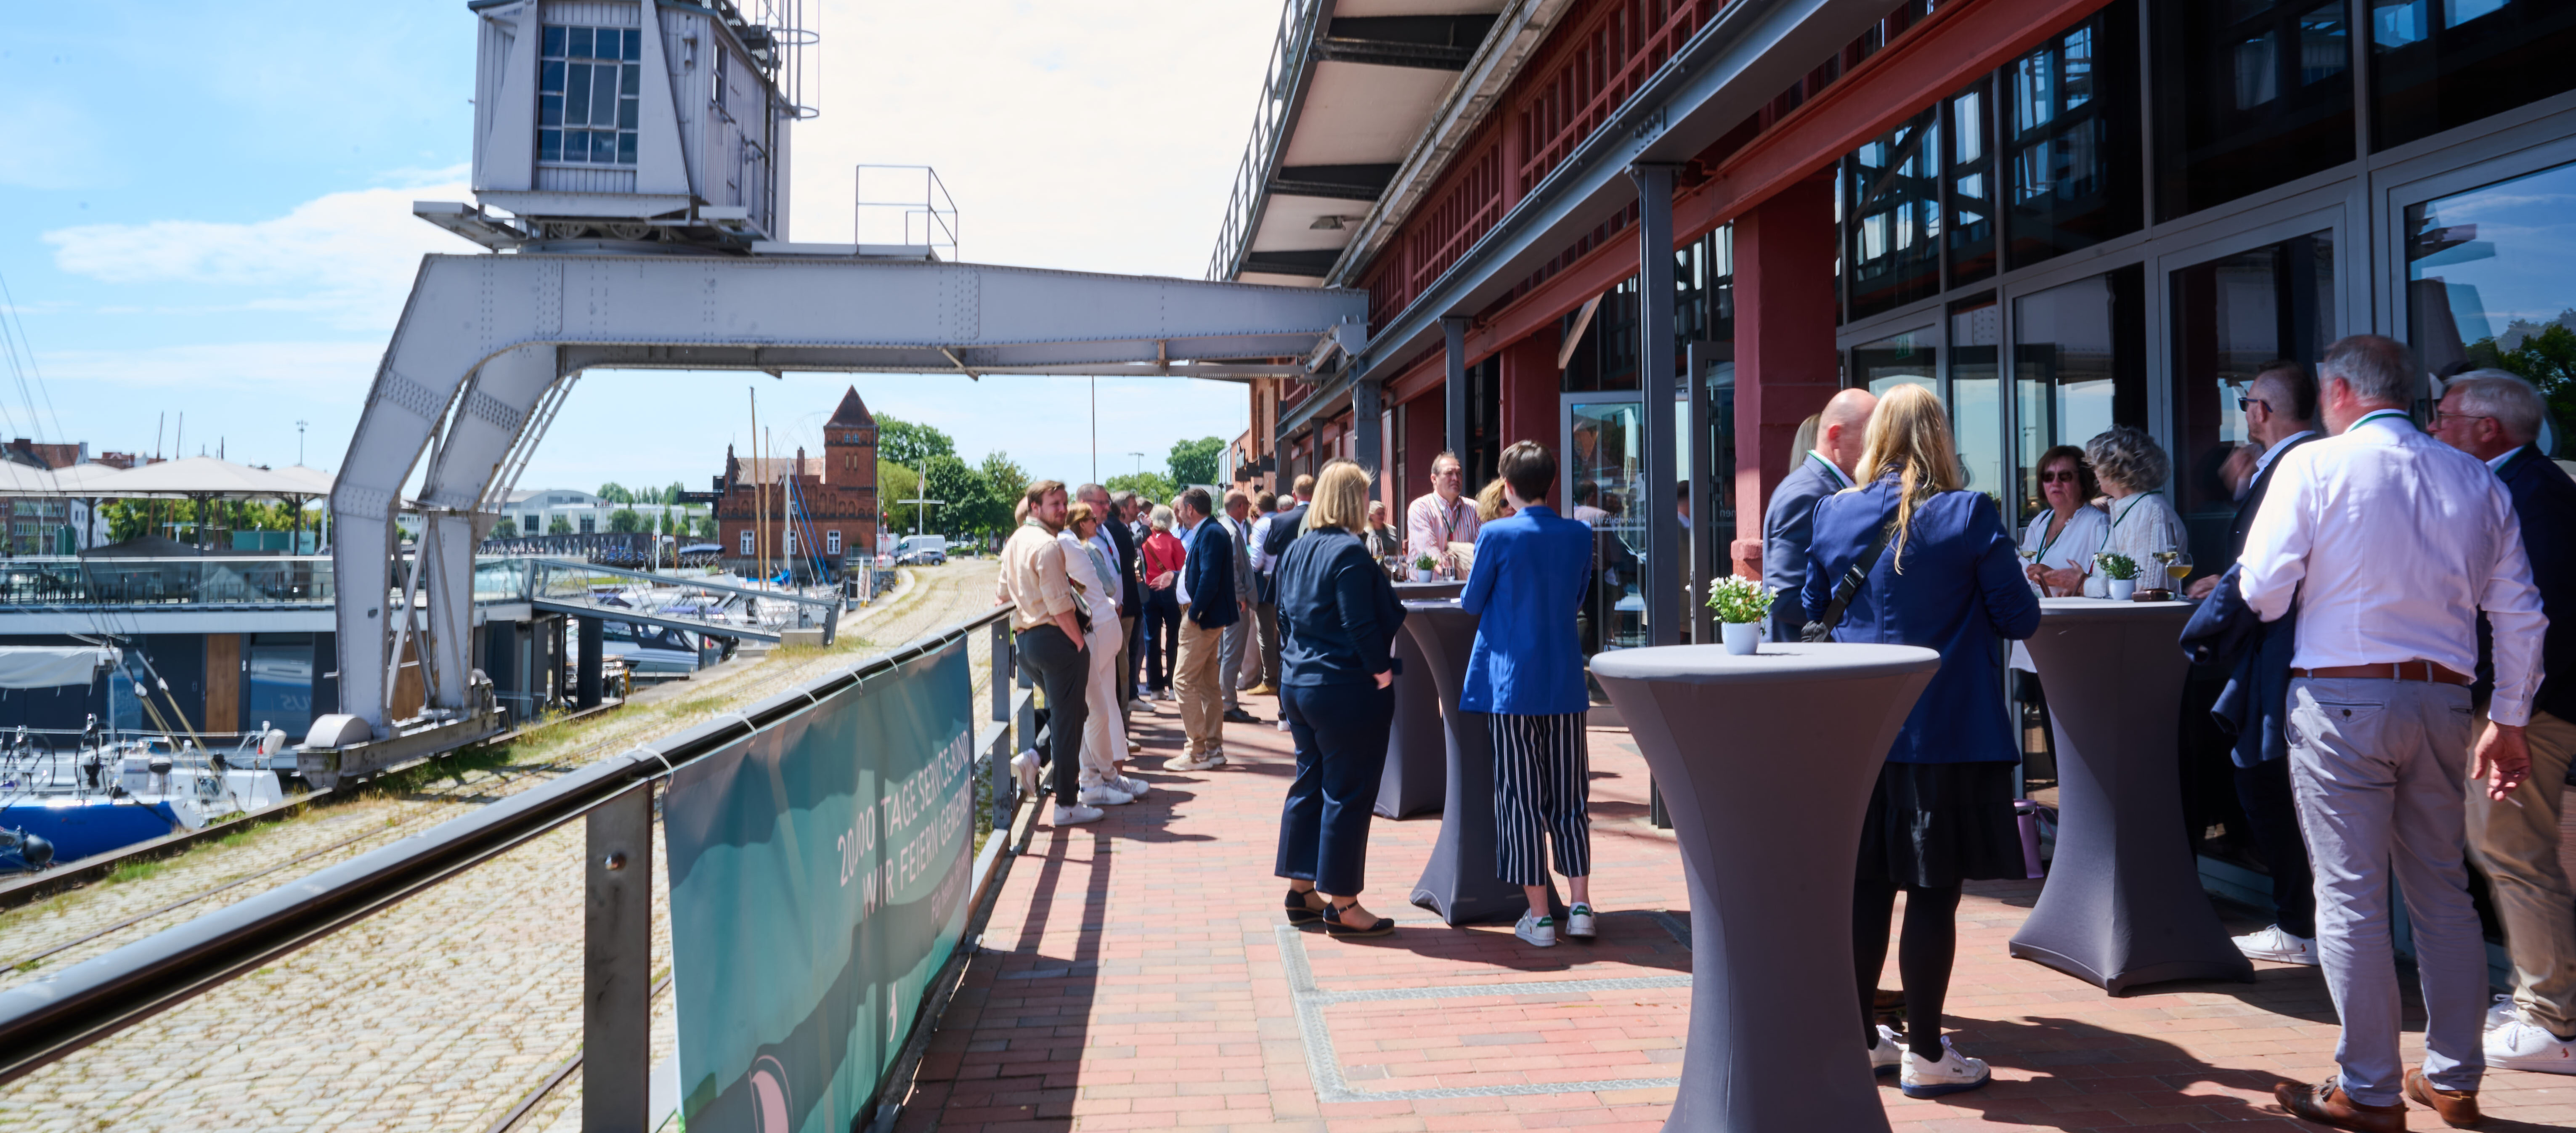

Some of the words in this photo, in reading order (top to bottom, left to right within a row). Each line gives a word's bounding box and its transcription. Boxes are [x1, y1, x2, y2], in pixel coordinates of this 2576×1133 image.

[880, 779, 918, 840] TAGE
[918, 730, 969, 812] SERVICE-BUND
[862, 857, 894, 919] WIR
[900, 817, 938, 891] FEIERN
